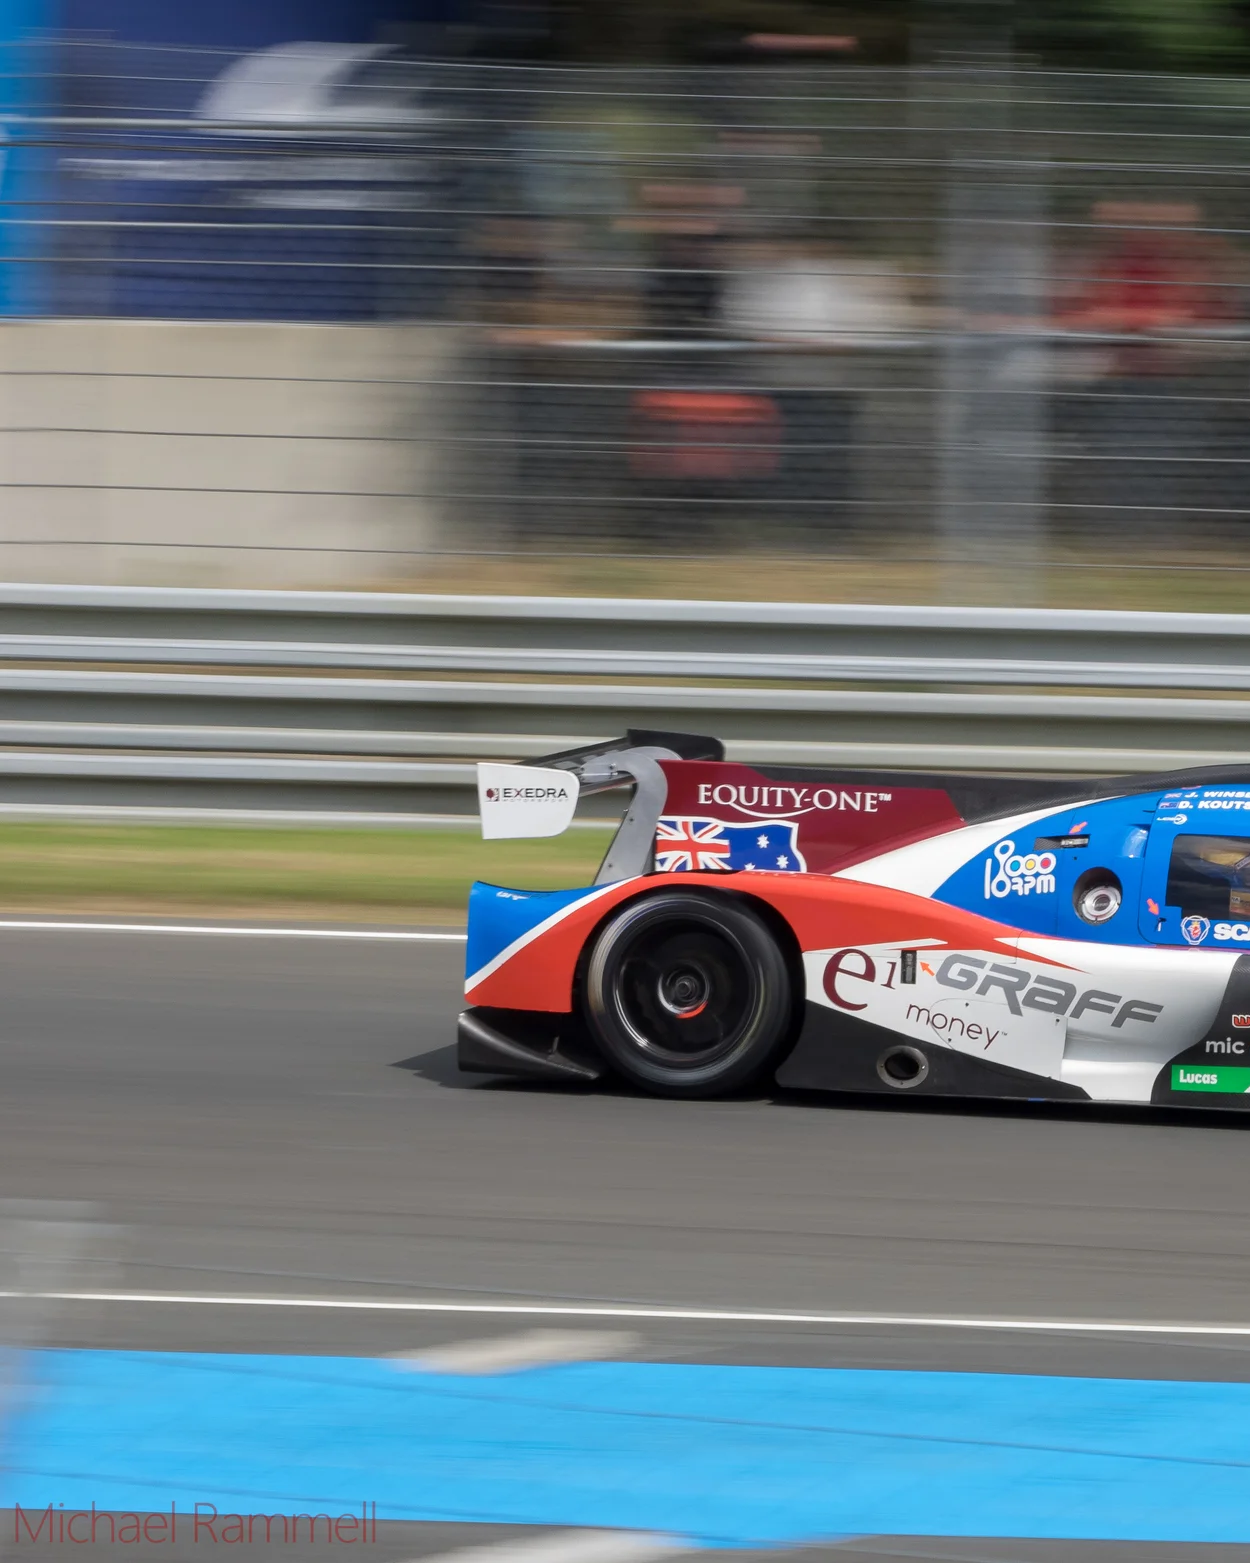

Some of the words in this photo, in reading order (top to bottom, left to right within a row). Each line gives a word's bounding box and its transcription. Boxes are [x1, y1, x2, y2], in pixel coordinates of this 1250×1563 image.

[503, 788, 568, 798] EXEDRA
[1178, 800, 1194, 809] D.
[905, 1003, 999, 1050] money
[1179, 1069, 1218, 1084] Lucas
